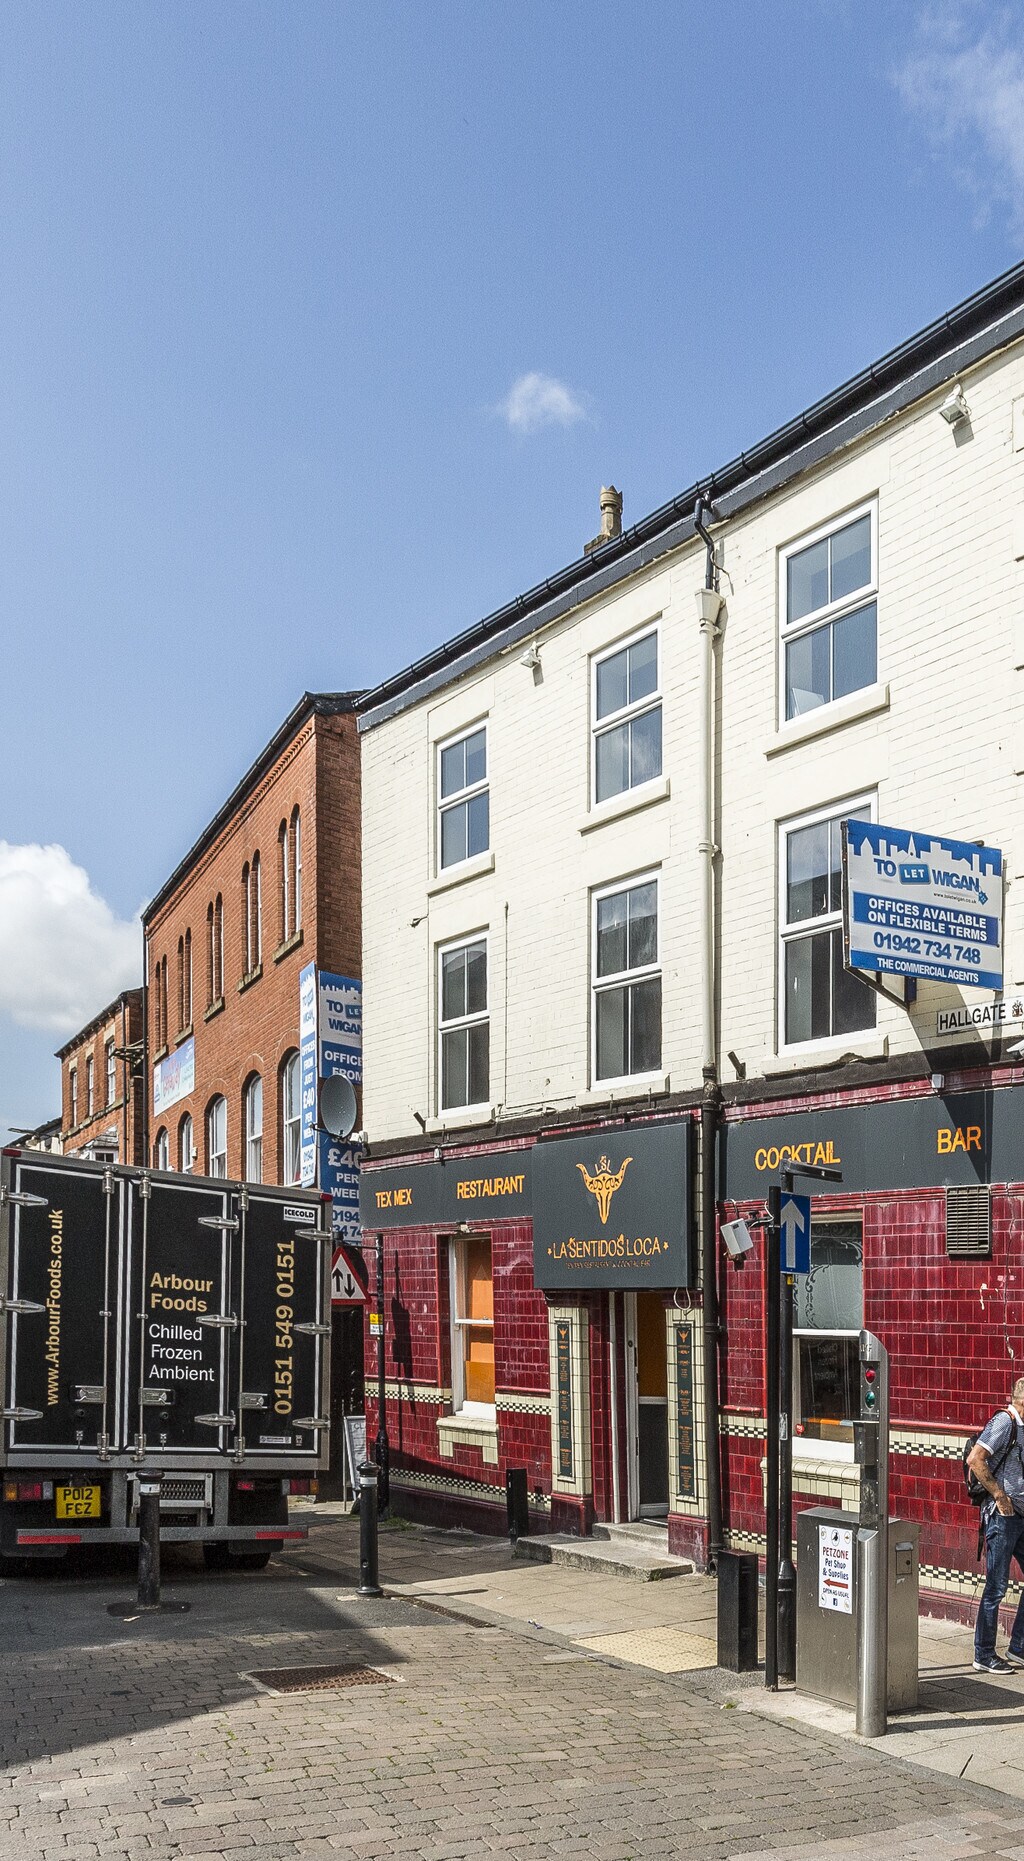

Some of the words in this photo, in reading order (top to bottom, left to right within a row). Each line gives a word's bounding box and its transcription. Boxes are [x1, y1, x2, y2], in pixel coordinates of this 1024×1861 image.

[873, 858, 897, 877] TO
[903, 868, 925, 878] LET
[932, 869, 980, 892] WIGAN
[868, 898, 919, 916] OFFICES
[923, 908, 987, 929] AVAILABLE
[868, 911, 886, 924] ON
[889, 914, 946, 934] FLEXIBLE
[949, 925, 987, 942] TERMS
[873, 931, 920, 952] 01942
[924, 940, 952, 959] 734
[954, 946, 981, 964] 748
[877, 957, 894, 970] THE
[894, 960, 947, 978] COMMERCIAL
[948, 969, 979, 983] AGENTS
[326, 999, 343, 1014] TO
[939, 1003, 1006, 1031] HALLGATE
[324, 1050, 362, 1066] OFFICE
[937, 1126, 982, 1154] BAR
[755, 1141, 841, 1171] COCKTAIL
[336, 1172, 359, 1184] PER
[457, 1175, 525, 1200] RESTAURANT
[331, 1187, 359, 1199] WEE
[376, 1191, 392, 1208] TEX
[393, 1188, 413, 1206] MEX
[285, 1208, 314, 1219] ICECOLD
[553, 1240, 567, 1259] LA
[567, 1233, 625, 1259] SENTIDOS
[626, 1237, 662, 1257] LOCA
[276, 1240, 295, 1298] 0151
[150, 1272, 214, 1293] Arbour
[45, 1208, 64, 1406] www.ArbourFoods.co.uk
[150, 1293, 208, 1313] Foods
[149, 1324, 203, 1342] Chilled
[275, 1304, 294, 1349] 549
[151, 1344, 203, 1361] Frozen
[149, 1365, 215, 1382] Ambient
[274, 1356, 293, 1415] 0151
[63, 1488, 93, 1501] PO12
[823, 1546, 849, 1560] PETZONE
[822, 1567, 827, 1576] &
[828, 1568, 849, 1580] Supplies
[825, 1558, 833, 1567] Pet
[834, 1560, 846, 1570] Shop
